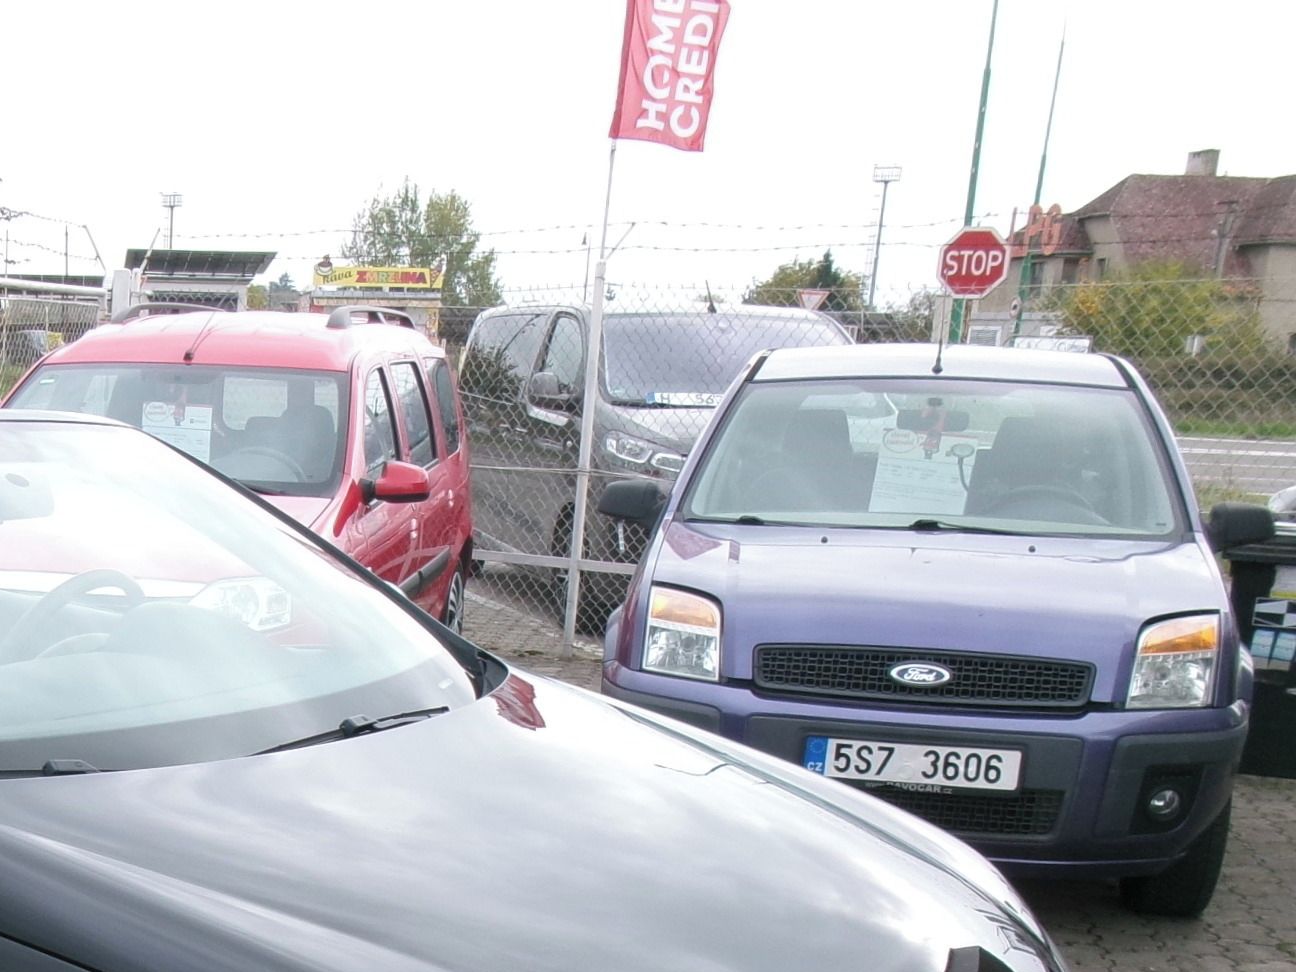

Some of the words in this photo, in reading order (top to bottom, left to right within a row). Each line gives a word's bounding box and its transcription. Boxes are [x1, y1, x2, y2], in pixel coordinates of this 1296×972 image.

[670, 0, 720, 138] CREDI
[944, 250, 1002, 276] STOP
[904, 668, 937, 681] Ford
[807, 761, 823, 772] CZ
[834, 742, 895, 776] 5S7
[921, 750, 1003, 784] 3606
